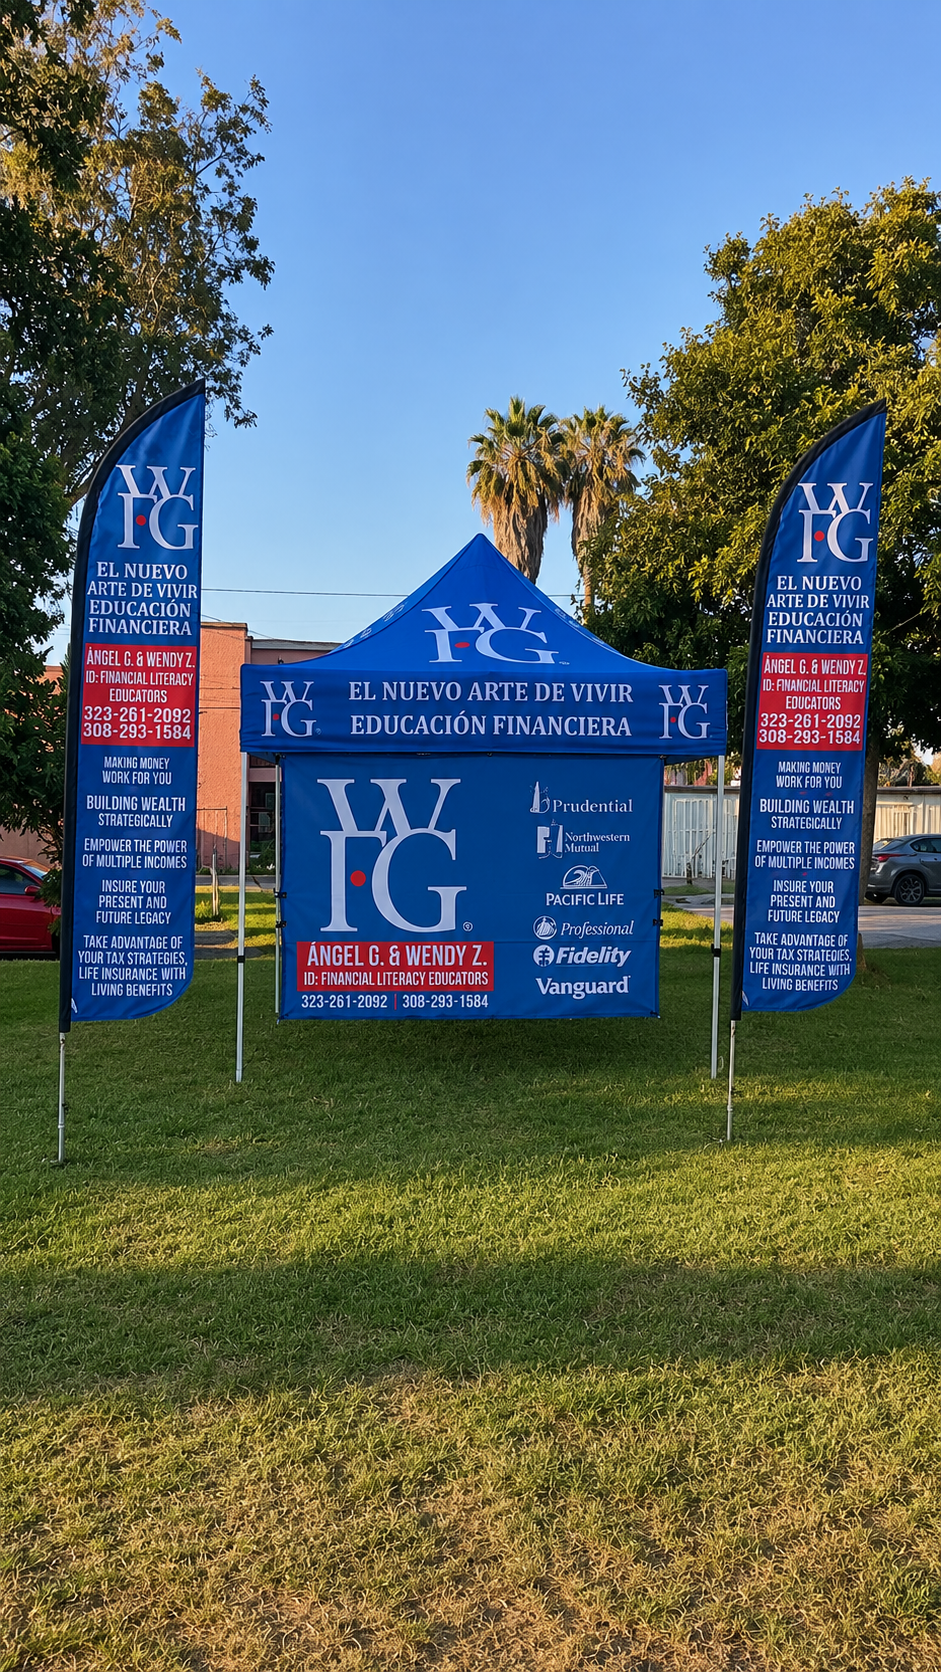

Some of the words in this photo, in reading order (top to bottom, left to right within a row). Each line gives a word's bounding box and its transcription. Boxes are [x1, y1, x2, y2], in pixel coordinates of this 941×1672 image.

[96, 562, 118, 578] EL
[124, 563, 188, 580] NUEVO
[87, 581, 127, 597] ARTE
[132, 582, 152, 598] DE
[156, 583, 197, 599] VIVIR
[777, 576, 797, 590] EL
[802, 576, 861, 591] NUEVO
[89, 598, 191, 617] EDUCACIÓN
[766, 594, 803, 608] ARTE
[807, 594, 829, 608] DE
[832, 595, 869, 609] VIVIR
[768, 610, 863, 627] EDUCACIÓN
[88, 618, 192, 636] FINANCIERA
[766, 629, 863, 644] FINANCIERA
[136, 652, 143, 667] &
[146, 652, 183, 668] WENDY
[184, 653, 195, 668] Z.
[799, 660, 809, 674] G.
[812, 660, 818, 674] &
[821, 659, 855, 675] WENDY
[857, 660, 866, 676] Z.
[86, 670, 98, 684] ID:
[100, 671, 148, 685] FINANCIAL
[150, 672, 193, 686] LITERACY
[348, 681, 376, 701] EL
[381, 682, 462, 702] NUEVO
[467, 682, 528, 702] ARTE
[534, 682, 566, 702] DE
[572, 683, 633, 703] VIVIR
[762, 679, 775, 691] ID:
[777, 679, 822, 692] FINANCIAL
[824, 680, 864, 693] LITERACY
[109, 689, 168, 703] EDUCATORS
[786, 696, 841, 710] EDUCATORS
[84, 706, 191, 724] 323-261-2092
[760, 713, 861, 729] 323-261-2092
[350, 710, 487, 735] EDUCACIÓN
[493, 716, 632, 736] FINANCIERA
[83, 722, 191, 740] 308-293-1584
[759, 729, 860, 744] 308-293-1584
[104, 756, 138, 769] MAKING
[140, 757, 169, 770] MONEY
[778, 761, 811, 774] MAKING
[812, 762, 841, 774] MONEY
[102, 771, 130, 784] WORK
[132, 772, 150, 784] FOR
[153, 772, 172, 785] YOU
[776, 775, 802, 788] WORK
[805, 776, 822, 788] FOR
[824, 776, 842, 789] YOU
[86, 796, 138, 811] BUILDING
[141, 797, 186, 812] WEALTH
[553, 799, 633, 812] Prudential
[760, 799, 810, 814] BUILDING
[812, 800, 854, 814] WEALTH
[98, 814, 173, 828] STRATEGICALLY
[771, 816, 842, 830] STRATEGICALLY
[565, 832, 630, 842] Northwestern
[84, 838, 132, 852] EMPOWER
[134, 840, 151, 852] THE
[154, 840, 187, 853] POWER
[565, 842, 599, 853] Mutual
[757, 840, 801, 853] EMPOWER
[804, 841, 821, 854] THE
[824, 841, 855, 854] POWER
[82, 854, 94, 867] OF
[96, 854, 141, 868] MULTIPLE
[144, 855, 187, 869] INCOMES
[755, 855, 766, 868] OF
[768, 856, 812, 869] MULTIPLE
[814, 856, 855, 869] INCOMES
[102, 880, 137, 893] INSURE
[139, 880, 165, 893] YOUR
[773, 879, 807, 892] INSURE
[809, 880, 834, 893] YOUR
[98, 895, 144, 908] PRESENT
[146, 896, 167, 909] AND
[546, 893, 595, 906] PACIFIC
[598, 892, 624, 905] LIFE
[770, 894, 813, 908] PRESENT
[816, 895, 835, 908] AND
[96, 911, 132, 924] FUTURE
[135, 911, 171, 925] LEGACY
[768, 910, 802, 922] FUTURE
[805, 910, 840, 924] LEGACY
[561, 920, 634, 939] Professional
[83, 934, 108, 948] TAKE
[111, 935, 168, 949] ADVANTAGE
[170, 936, 183, 949] OF
[754, 932, 778, 945] TAKE
[781, 932, 835, 947] ADVANTAGE
[838, 934, 848, 947] OF
[78, 951, 103, 964] YOUR
[105, 951, 125, 965] TAX
[307, 941, 364, 966] ÁNGEL
[369, 945, 384, 966] G.
[389, 945, 400, 966] &
[406, 945, 467, 966] WENDY
[472, 945, 487, 966] Z.
[556, 946, 632, 967] Fidelity
[750, 947, 774, 960] YOUR
[776, 948, 794, 960] TAX
[79, 967, 98, 980] LIFE
[101, 967, 158, 980] INSURANCE
[161, 967, 186, 980] WITH
[750, 962, 769, 974] LIFE
[772, 962, 826, 976] INSURANCE
[828, 963, 850, 976] WITH
[304, 972, 318, 985] ID:
[321, 972, 375, 986] FINANCIAL
[377, 972, 427, 986] LITERACY
[429, 972, 488, 985] EDUCATORS
[762, 977, 792, 991] LIVING
[796, 978, 838, 991] BENEFITS
[92, 983, 123, 996] LIVING
[126, 983, 172, 996] BENEFITS
[536, 976, 629, 1000] Vanguard
[302, 995, 387, 1008] 323-261-2092
[402, 995, 488, 1008] 308-293-1584
